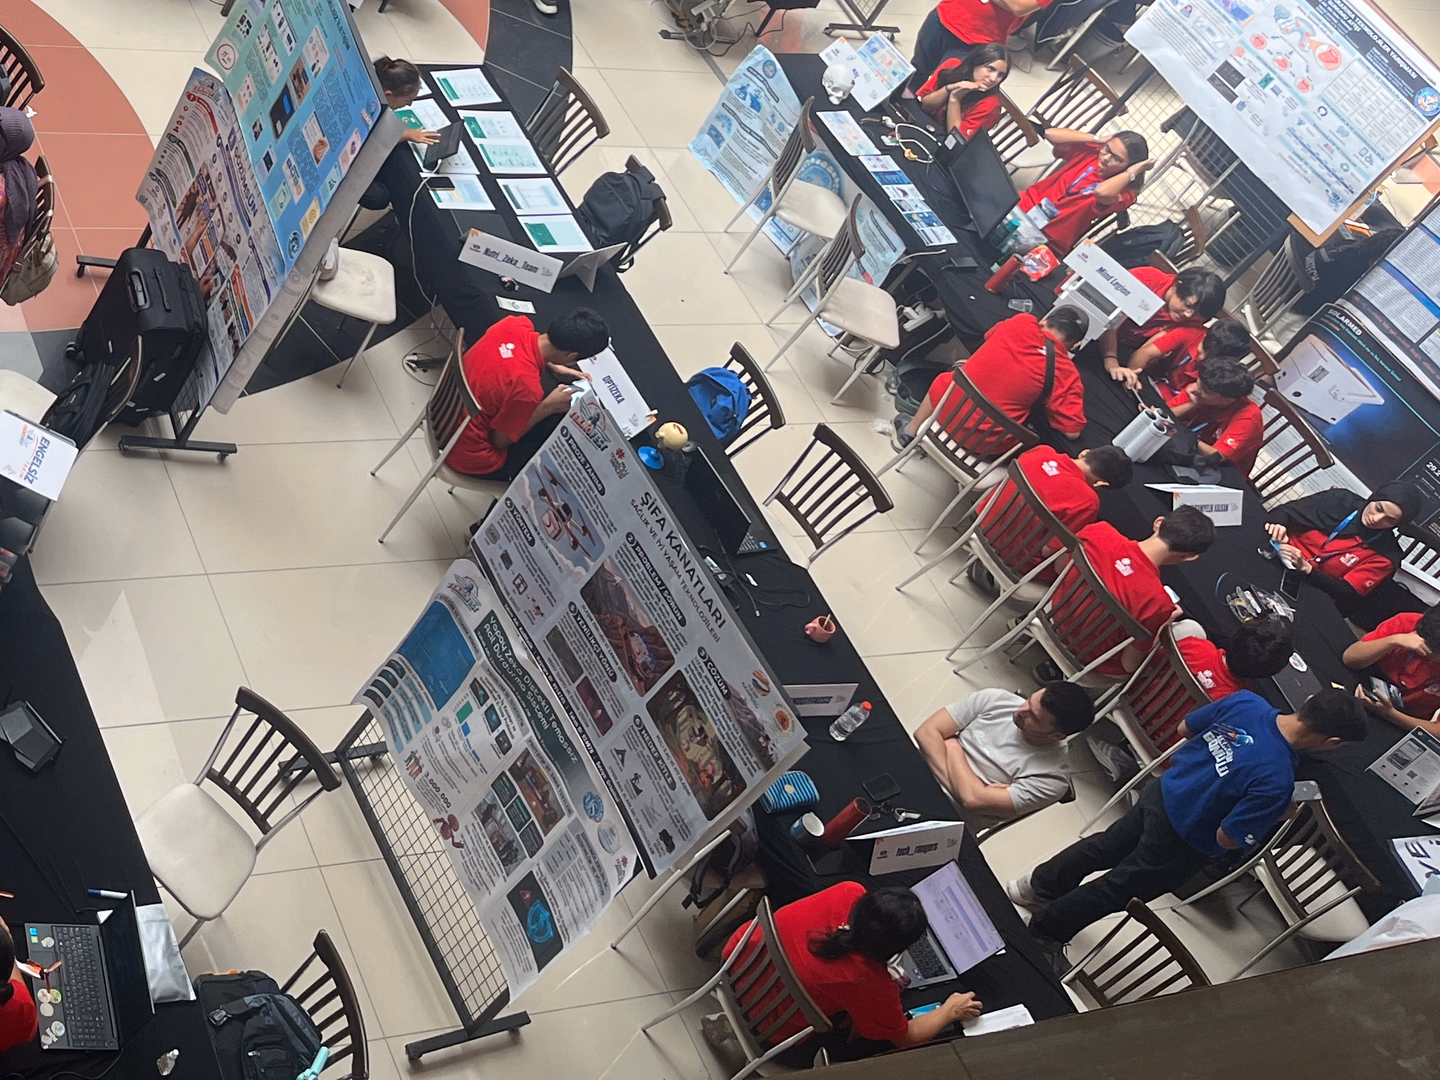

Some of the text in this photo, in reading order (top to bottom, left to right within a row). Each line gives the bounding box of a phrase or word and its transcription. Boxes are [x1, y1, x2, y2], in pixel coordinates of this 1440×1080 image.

[1352, 17, 1391, 53] TEKNOLOJİLER
[1388, 51, 1418, 79] YARIŞMASI
[482, 247, 539, 274] Nutri_Zeka_Team
[1093, 264, 1131, 297] Mind Legion
[1327, 307, 1363, 337] SOLARMED
[602, 375, 625, 405] OPTİZEKA
[569, 411, 609, 452] TEKNOFEST
[23, 436, 51, 485] ENGELSİZ
[566, 437, 587, 465] PROJE
[582, 462, 603, 491] TANIMI
[509, 508, 535, 541] YÖNTEM
[628, 497, 651, 527] SAĞLIK
[646, 525, 659, 540] VE
[659, 549, 684, 580] YAŞAM
[632, 545, 662, 586] PROBLEM
[660, 589, 684, 620] SORUN
[637, 490, 730, 629] ŞİFA KANATLARI
[483, 615, 512, 652] Yapay
[503, 650, 524, 676] Zeka
[573, 613, 602, 654] YENİLİKÇİ
[597, 651, 616, 676] YÖNÜ
[480, 623, 552, 729] Acil Durdurma Sistemi
[704, 660, 731, 695] ÇÖZÜM
[639, 729, 660, 758] HEDEF
[656, 758, 675, 784] KİTLE
[421, 770, 453, 808] 3.000.000
